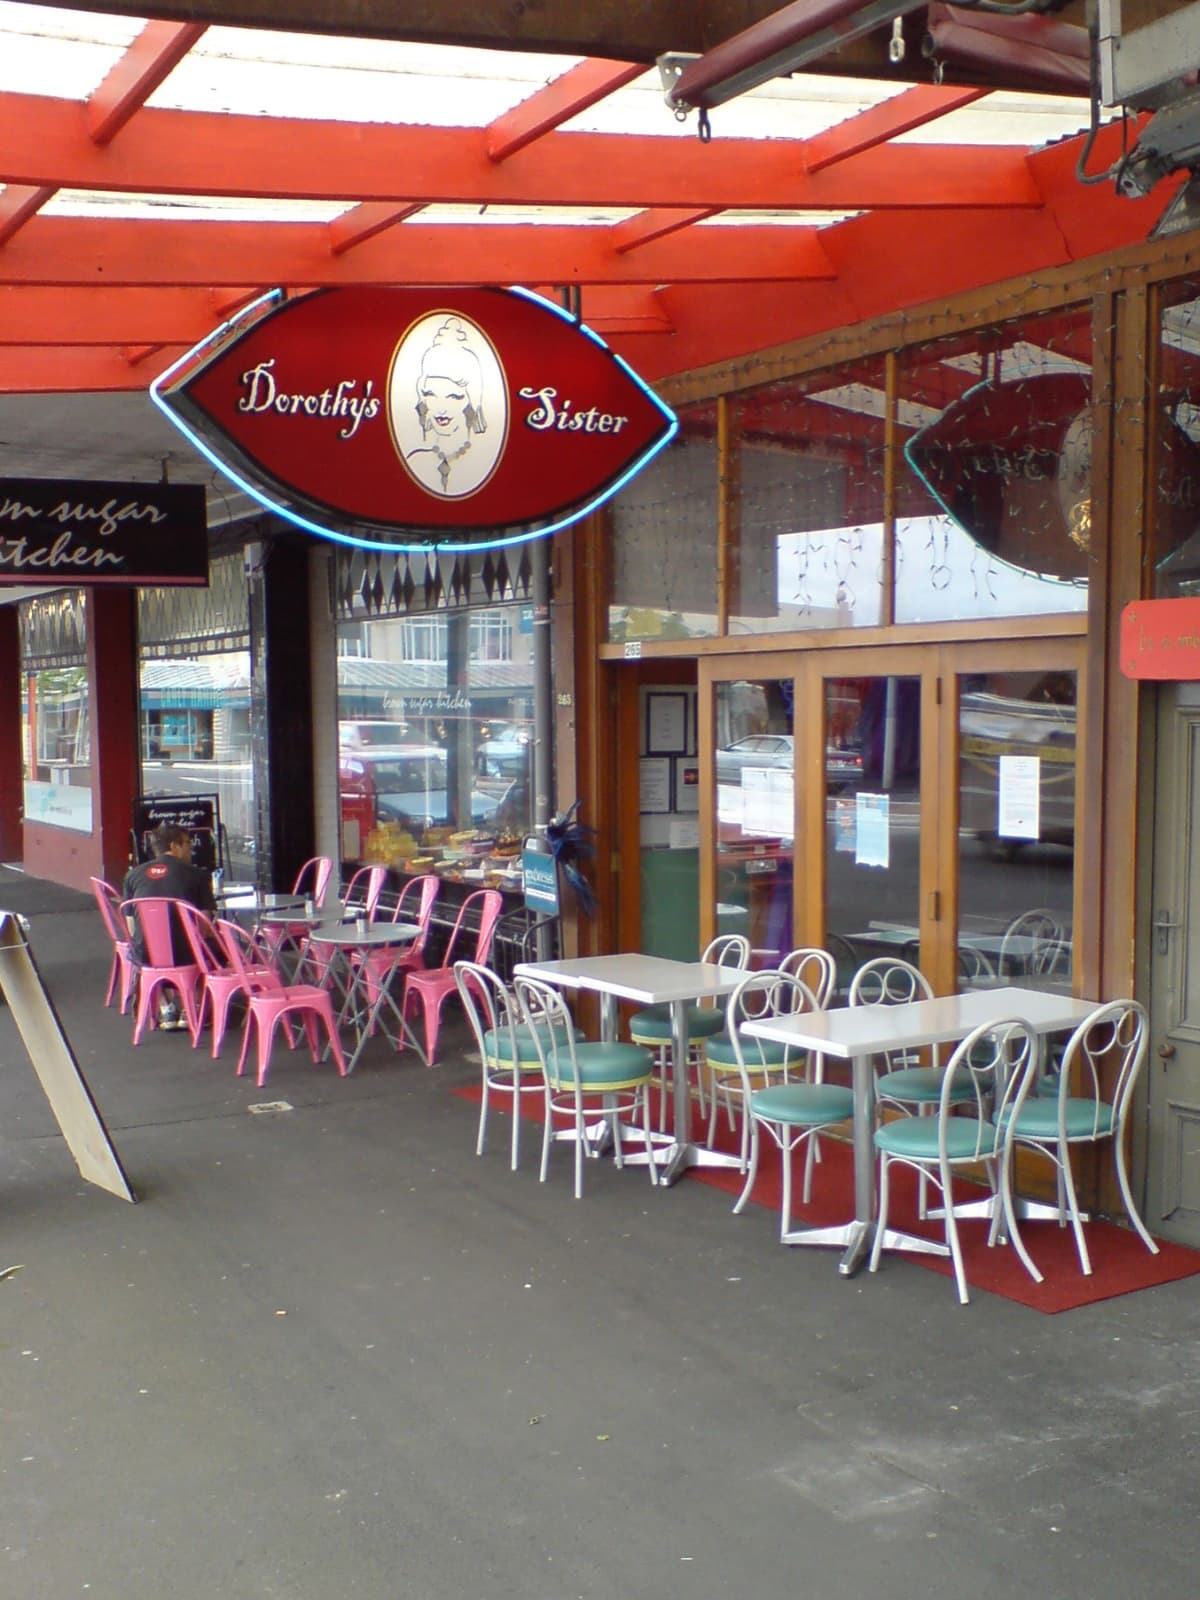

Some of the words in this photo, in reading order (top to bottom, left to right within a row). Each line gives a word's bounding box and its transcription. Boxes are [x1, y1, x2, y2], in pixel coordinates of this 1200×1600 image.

[239, 358, 380, 438] Dorothy's
[519, 387, 628, 433] Sister
[48, 499, 167, 535] sugar
